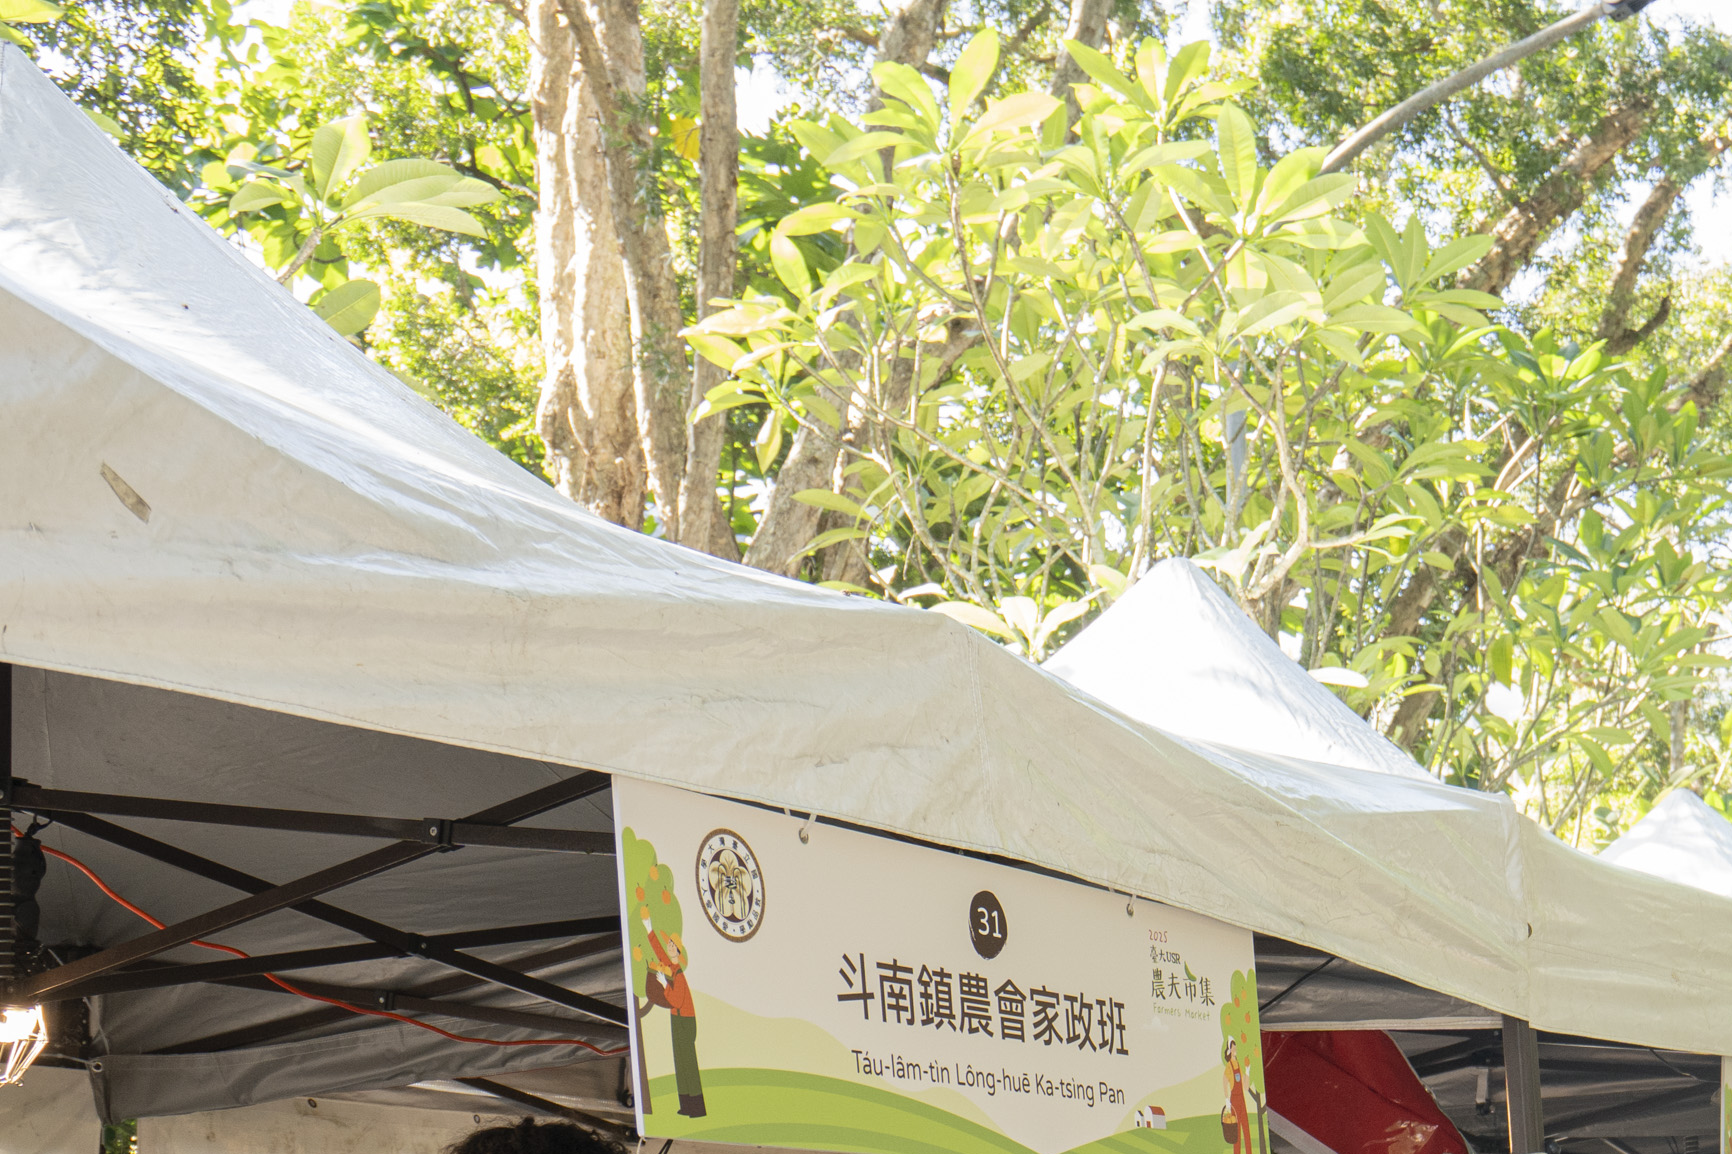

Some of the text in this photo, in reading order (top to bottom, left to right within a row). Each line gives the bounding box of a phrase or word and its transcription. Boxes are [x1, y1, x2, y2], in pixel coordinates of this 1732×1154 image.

[977, 907, 1002, 938] 31
[1149, 929, 1168, 943] 2025
[1151, 967, 1216, 1006] 農夫市集
[837, 953, 1129, 1056] 斗南鎮農會家政班
[1153, 1002, 1211, 1021] Farmers Market
[851, 1049, 1125, 1107] Táu-lâm-tìn Lông-huē Ka-tsìng Pan
